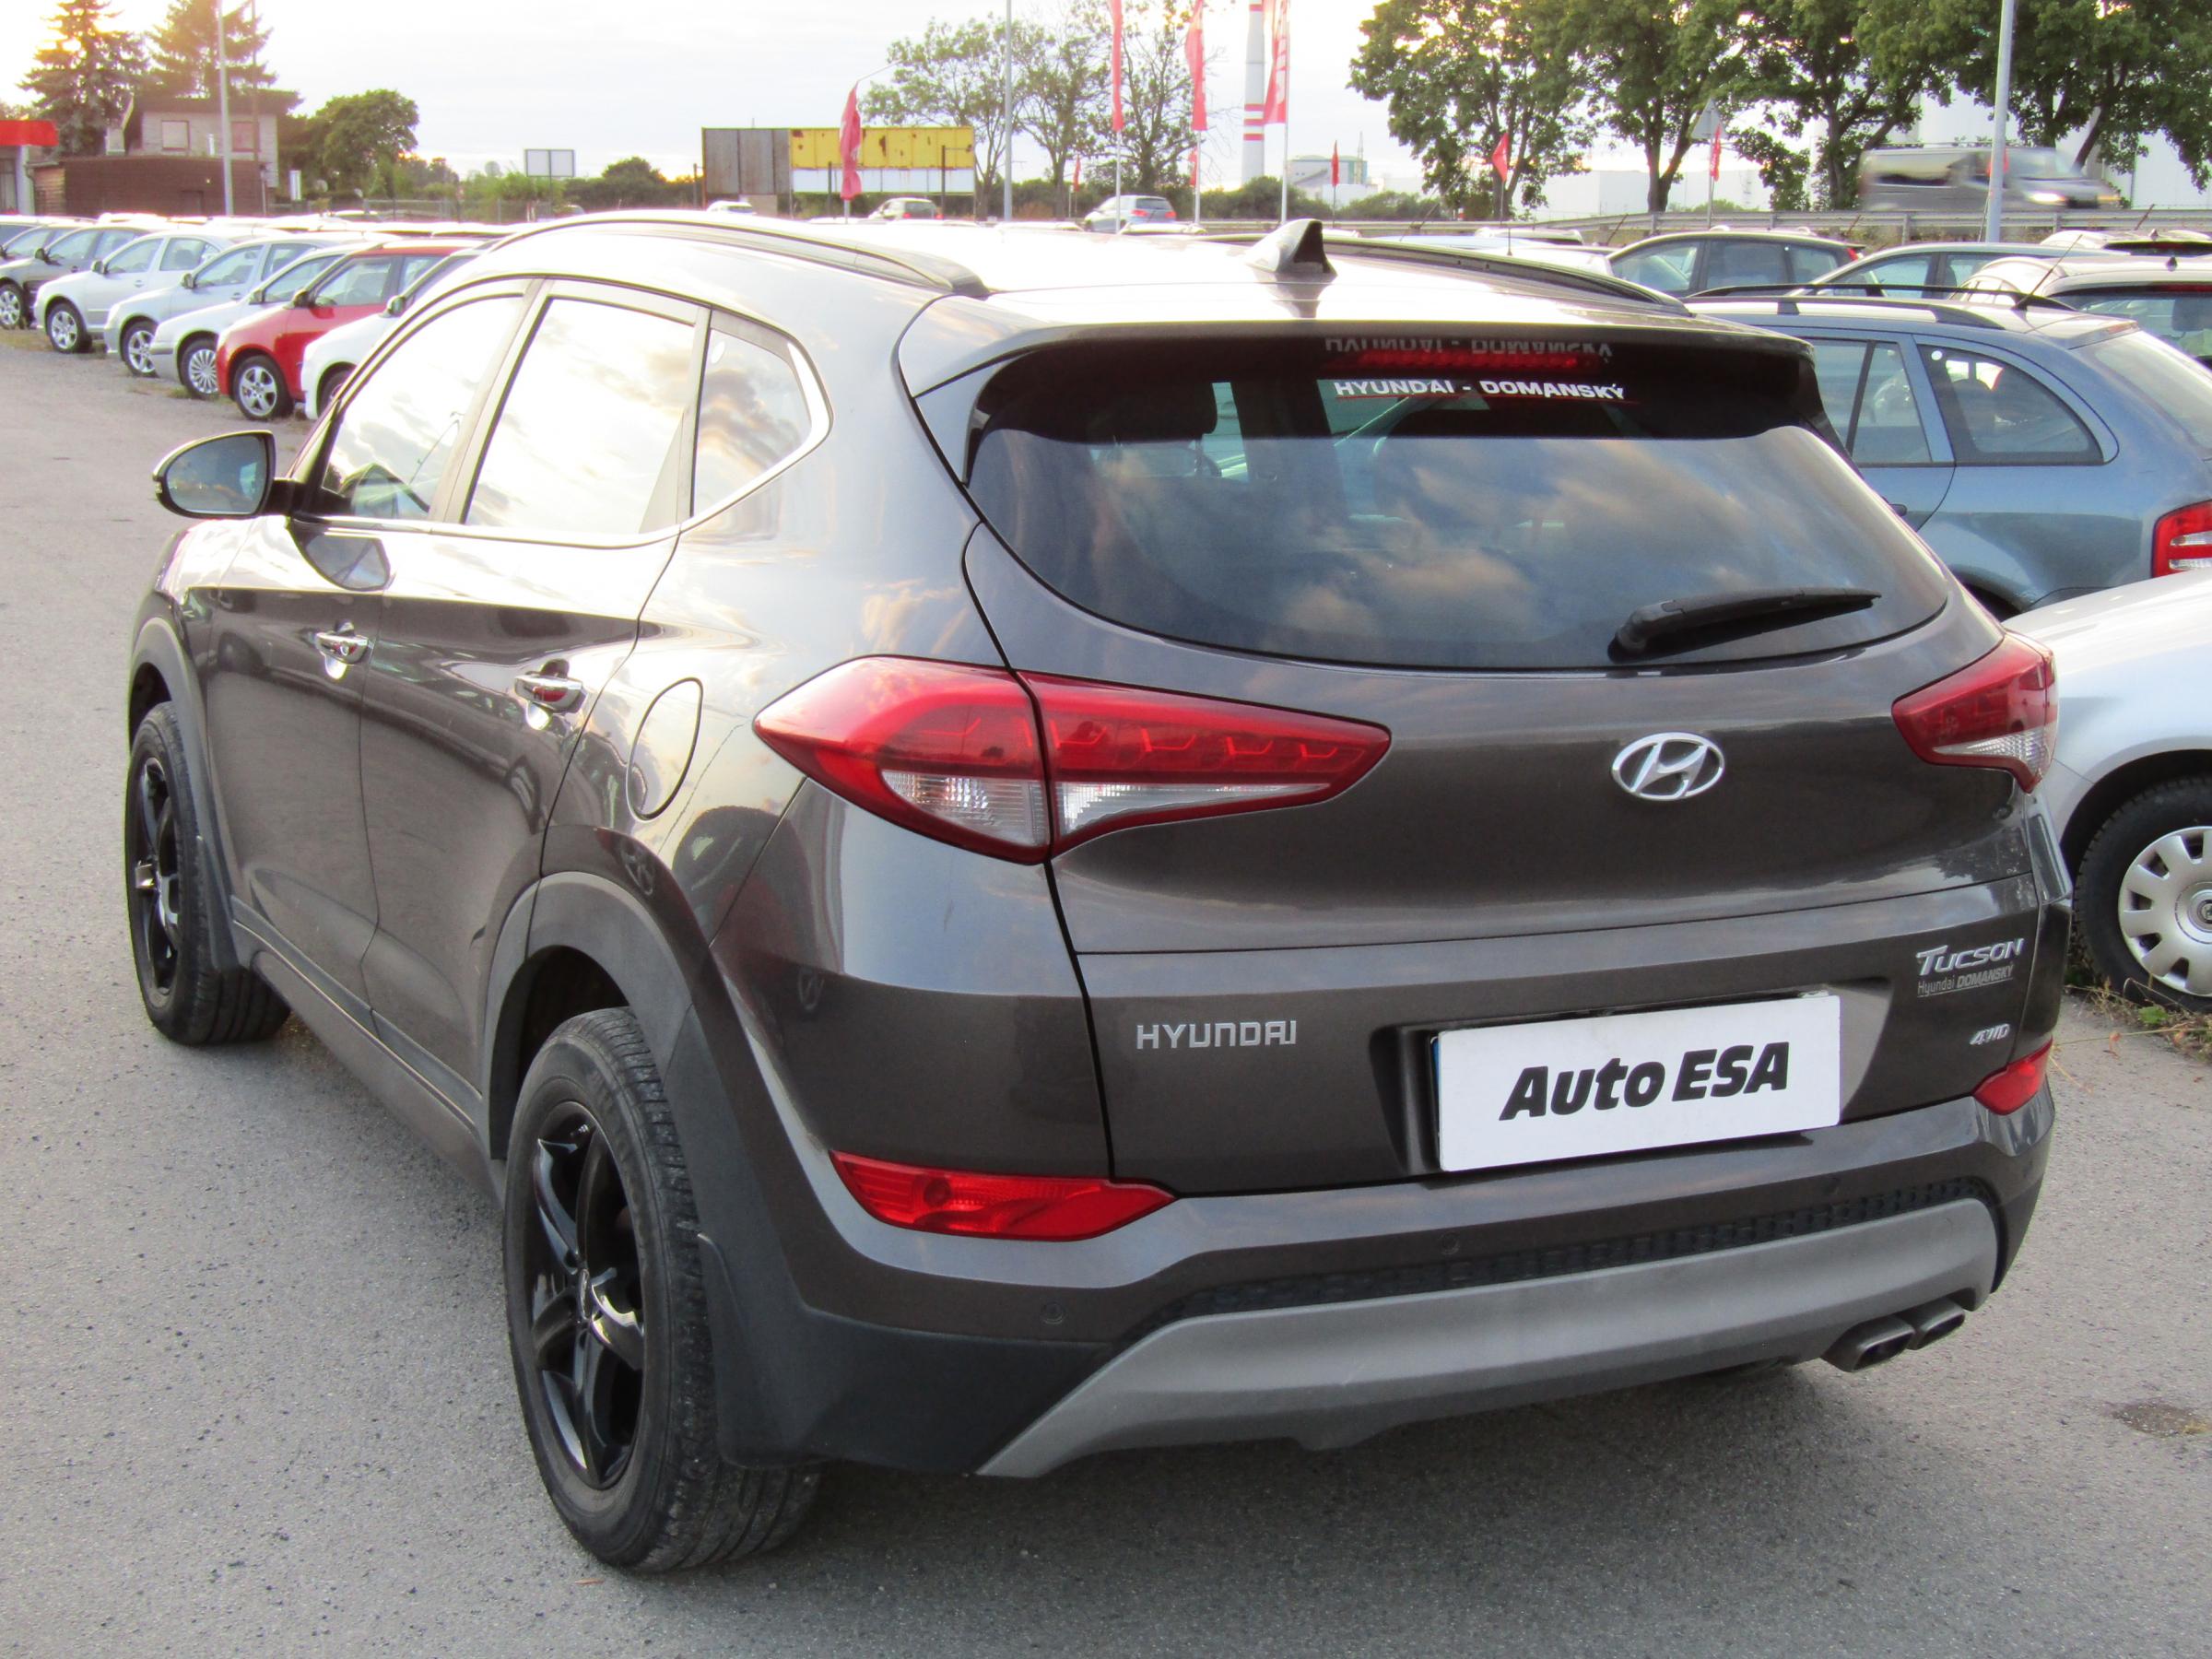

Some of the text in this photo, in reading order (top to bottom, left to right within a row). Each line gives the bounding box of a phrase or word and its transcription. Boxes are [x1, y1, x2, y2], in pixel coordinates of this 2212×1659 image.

[1334, 379, 1455, 396] HYUNDAI
[1478, 380, 1625, 400] DOMANSKÝ
[1917, 975, 1955, 997] Hyundai
[1135, 1019, 1298, 1051] HYUNDAI
[1498, 1041, 1791, 1122] Auto ESA
